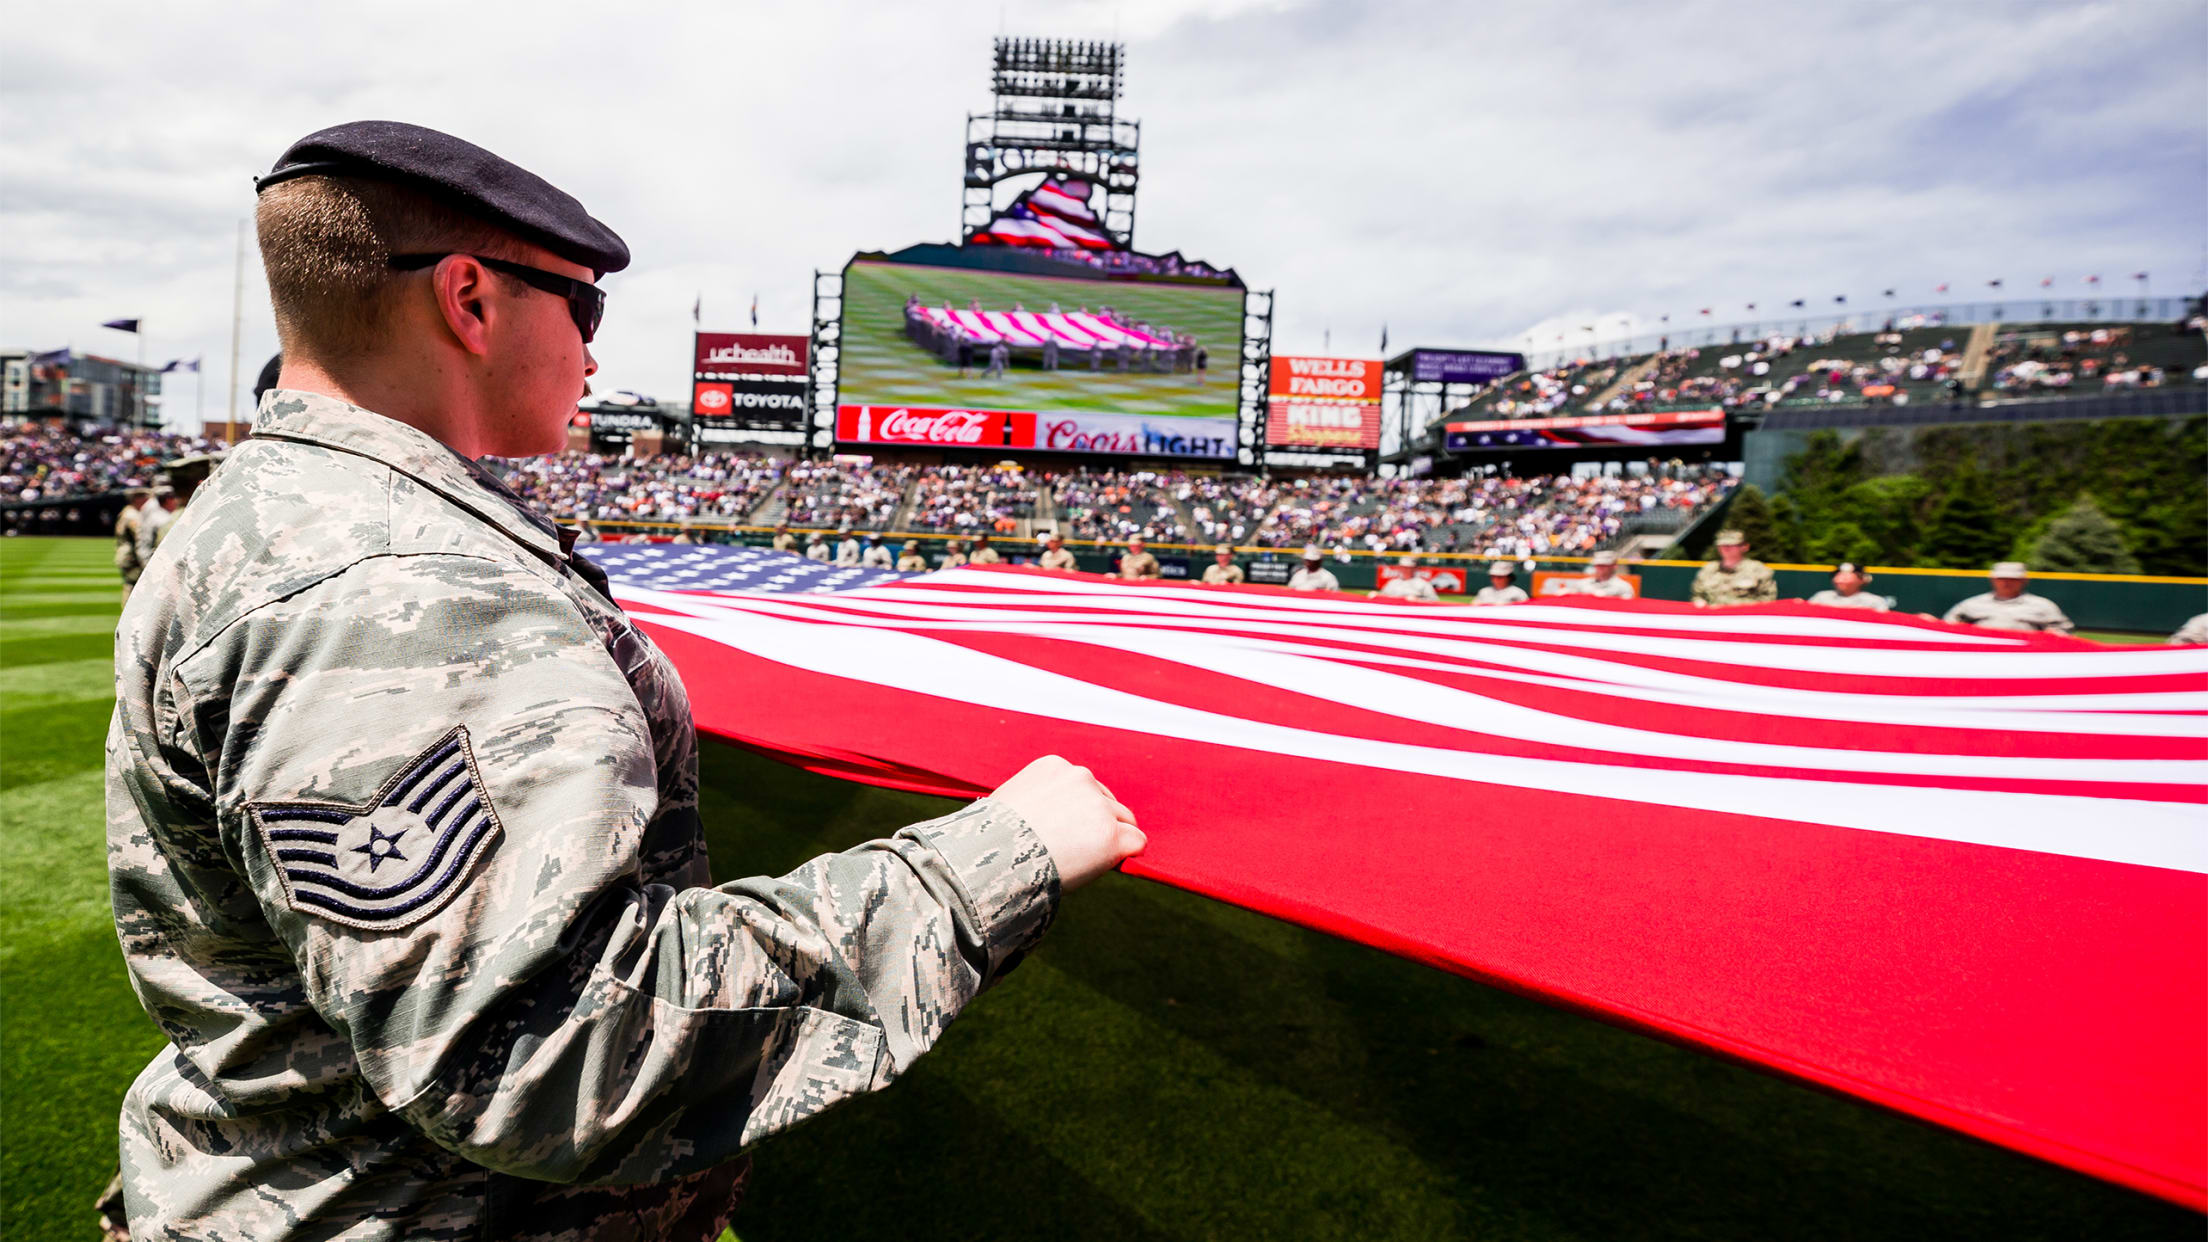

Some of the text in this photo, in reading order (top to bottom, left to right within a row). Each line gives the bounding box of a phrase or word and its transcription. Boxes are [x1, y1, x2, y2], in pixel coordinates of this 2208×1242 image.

[709, 342, 795, 363] uchealth
[1289, 358, 1366, 378] WELLS
[1289, 377, 1366, 396] FARGO
[733, 393, 803, 409] TOYOTA
[590, 414, 652, 428] TUNDRA
[1286, 405, 1362, 428] KING
[1046, 419, 1224, 455] Coors LIGHT
